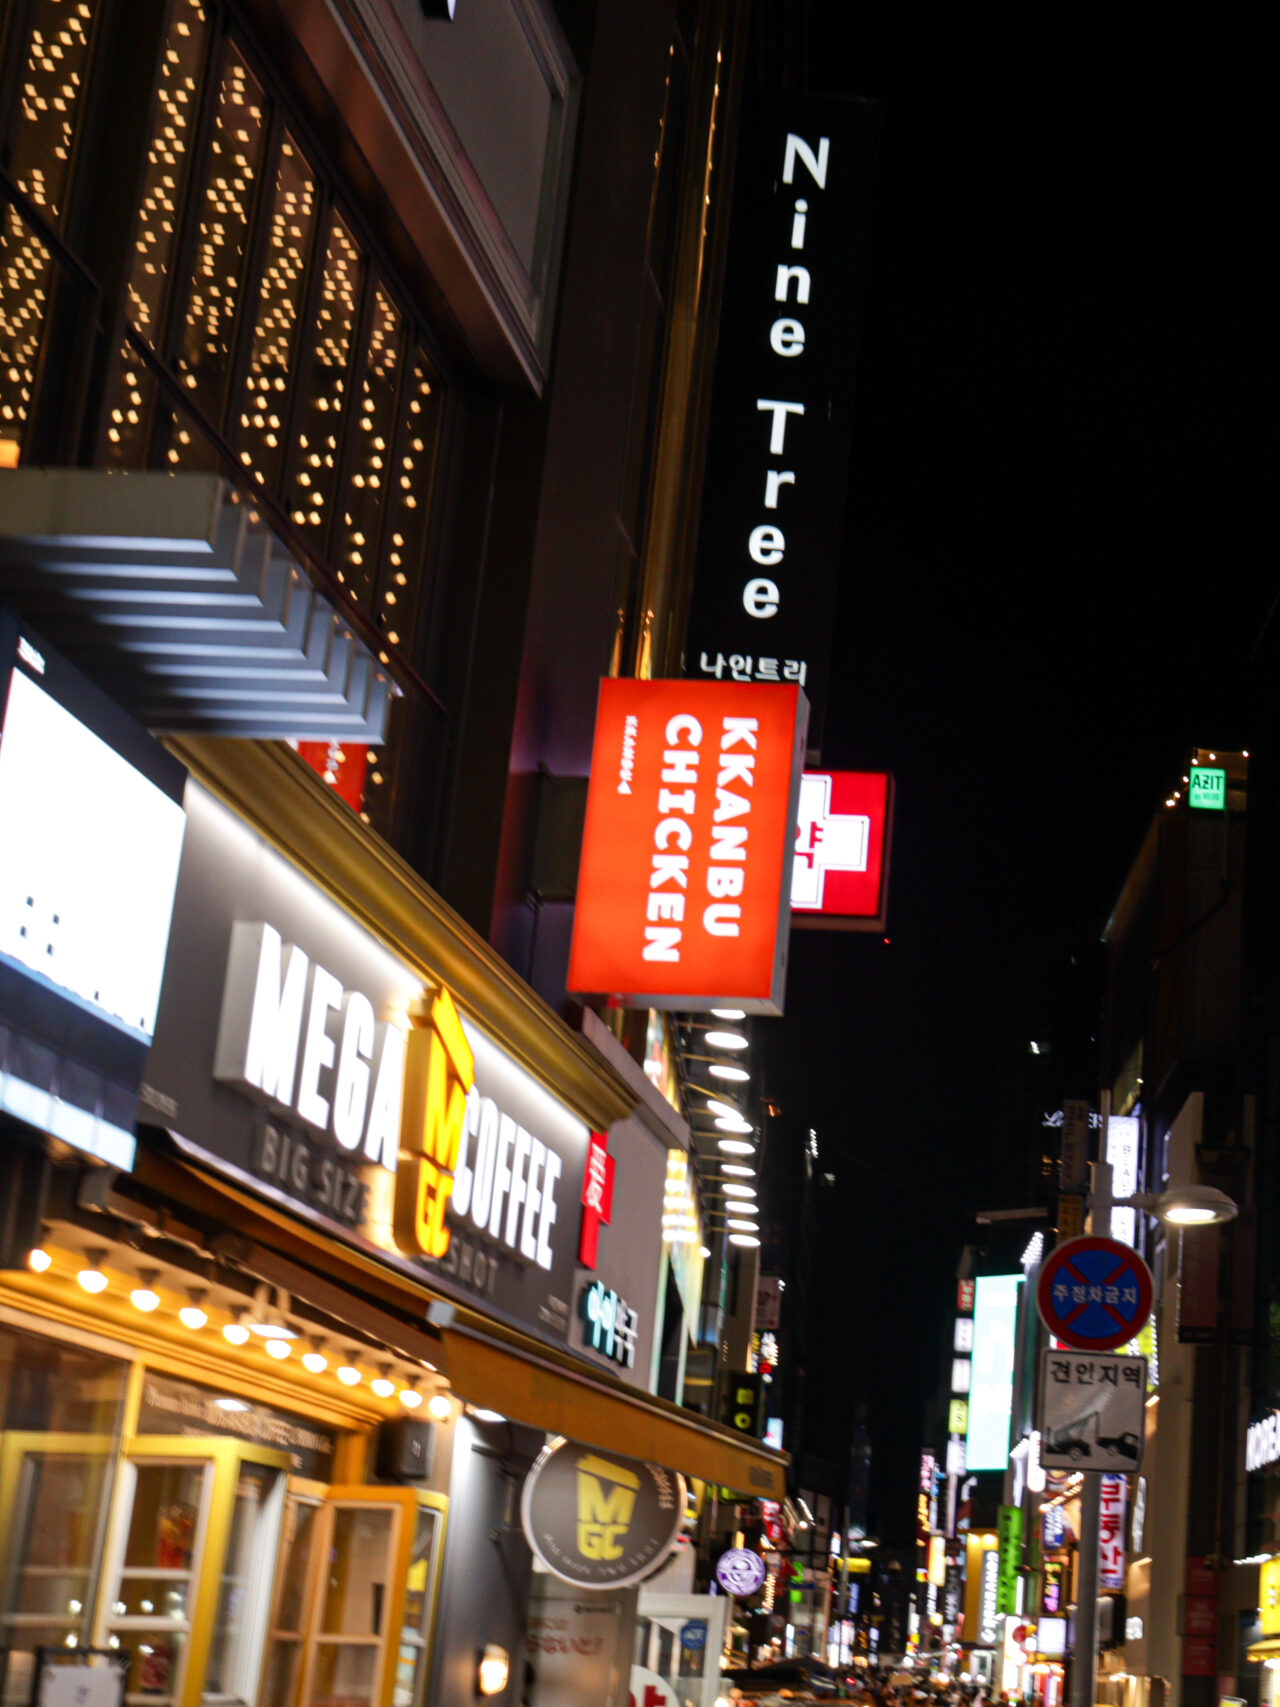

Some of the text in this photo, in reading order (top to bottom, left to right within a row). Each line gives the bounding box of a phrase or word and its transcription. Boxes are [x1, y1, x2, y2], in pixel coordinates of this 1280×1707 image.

[743, 133, 832, 620] Nine Tree
[700, 651, 808, 687] 나인트리
[642, 713, 703, 962] CHICKEN
[702, 716, 759, 938] KKANBU
[243, 921, 402, 1173] MEGA
[451, 1082, 563, 1271] COFFEE
[259, 1123, 310, 1192] BIG
[1053, 1283, 1138, 1305] 주정차금지
[1051, 1359, 1142, 1389] 견인지역
